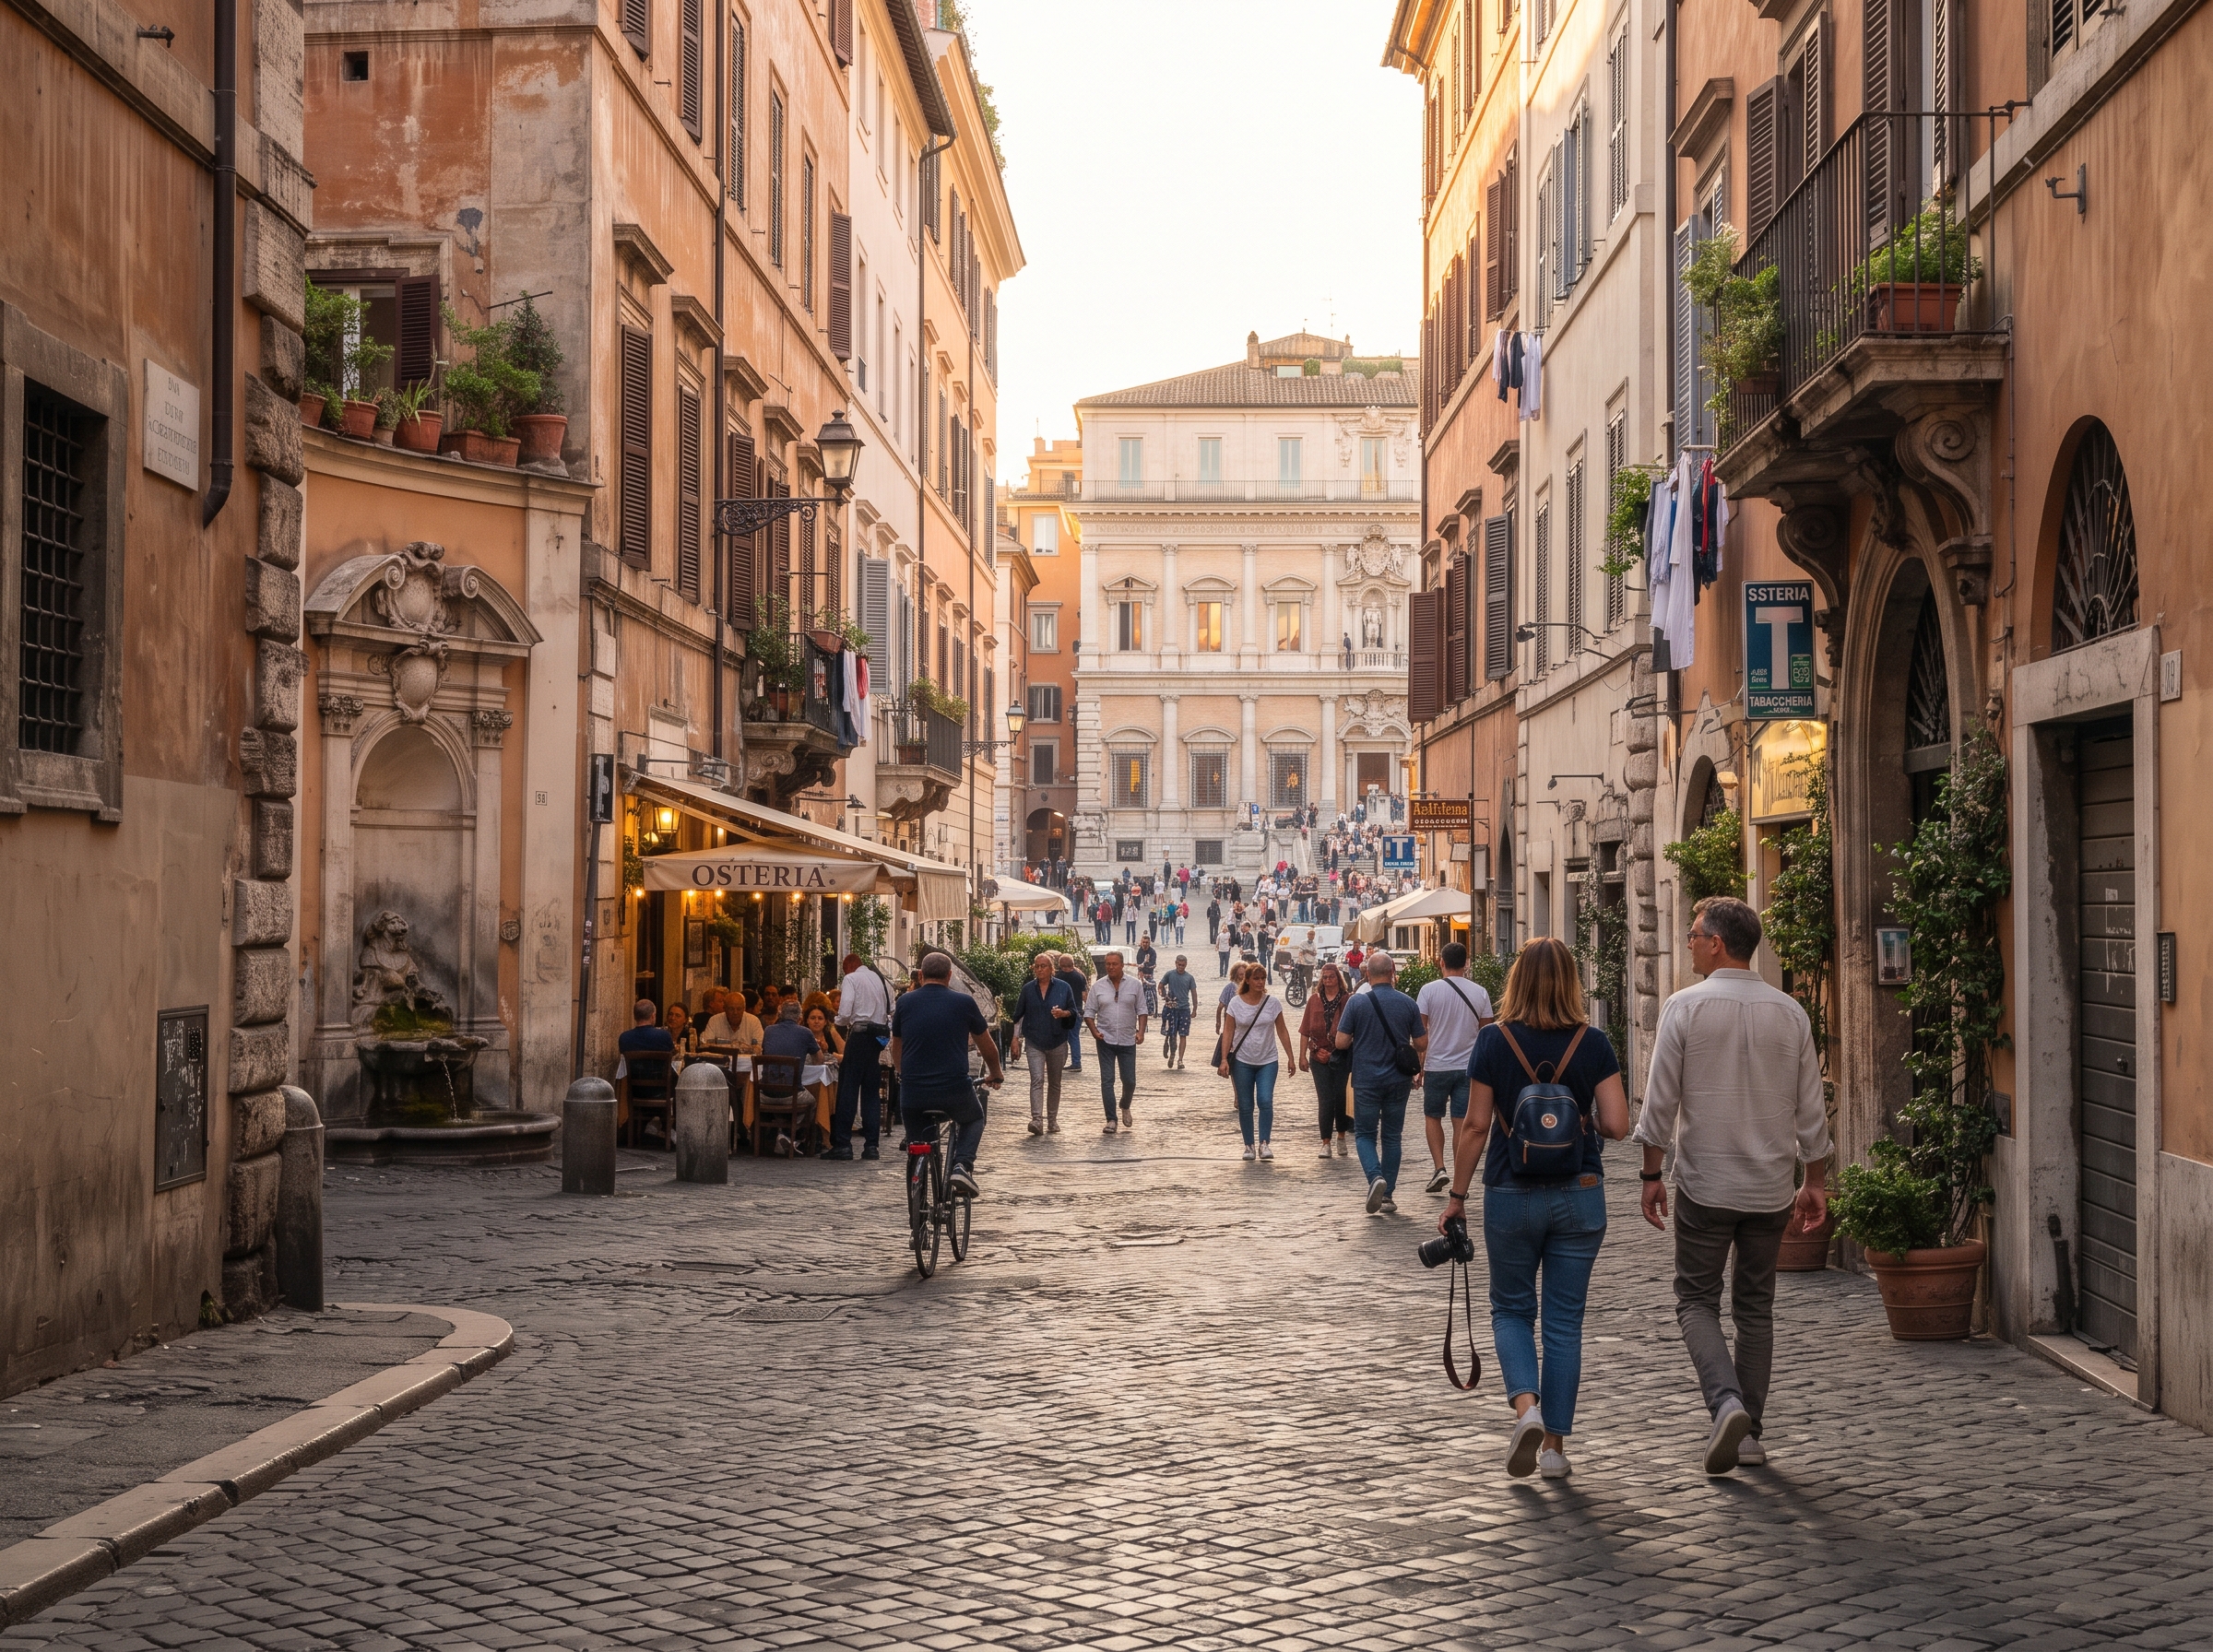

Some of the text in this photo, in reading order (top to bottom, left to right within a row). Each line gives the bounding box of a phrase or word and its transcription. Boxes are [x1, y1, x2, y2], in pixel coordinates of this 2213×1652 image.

[1748, 587, 1809, 602] SSTERIA
[1756, 607, 1804, 690] T
[1749, 696, 1813, 707] TABACCHERIA
[692, 865, 826, 888] OSTERIA
